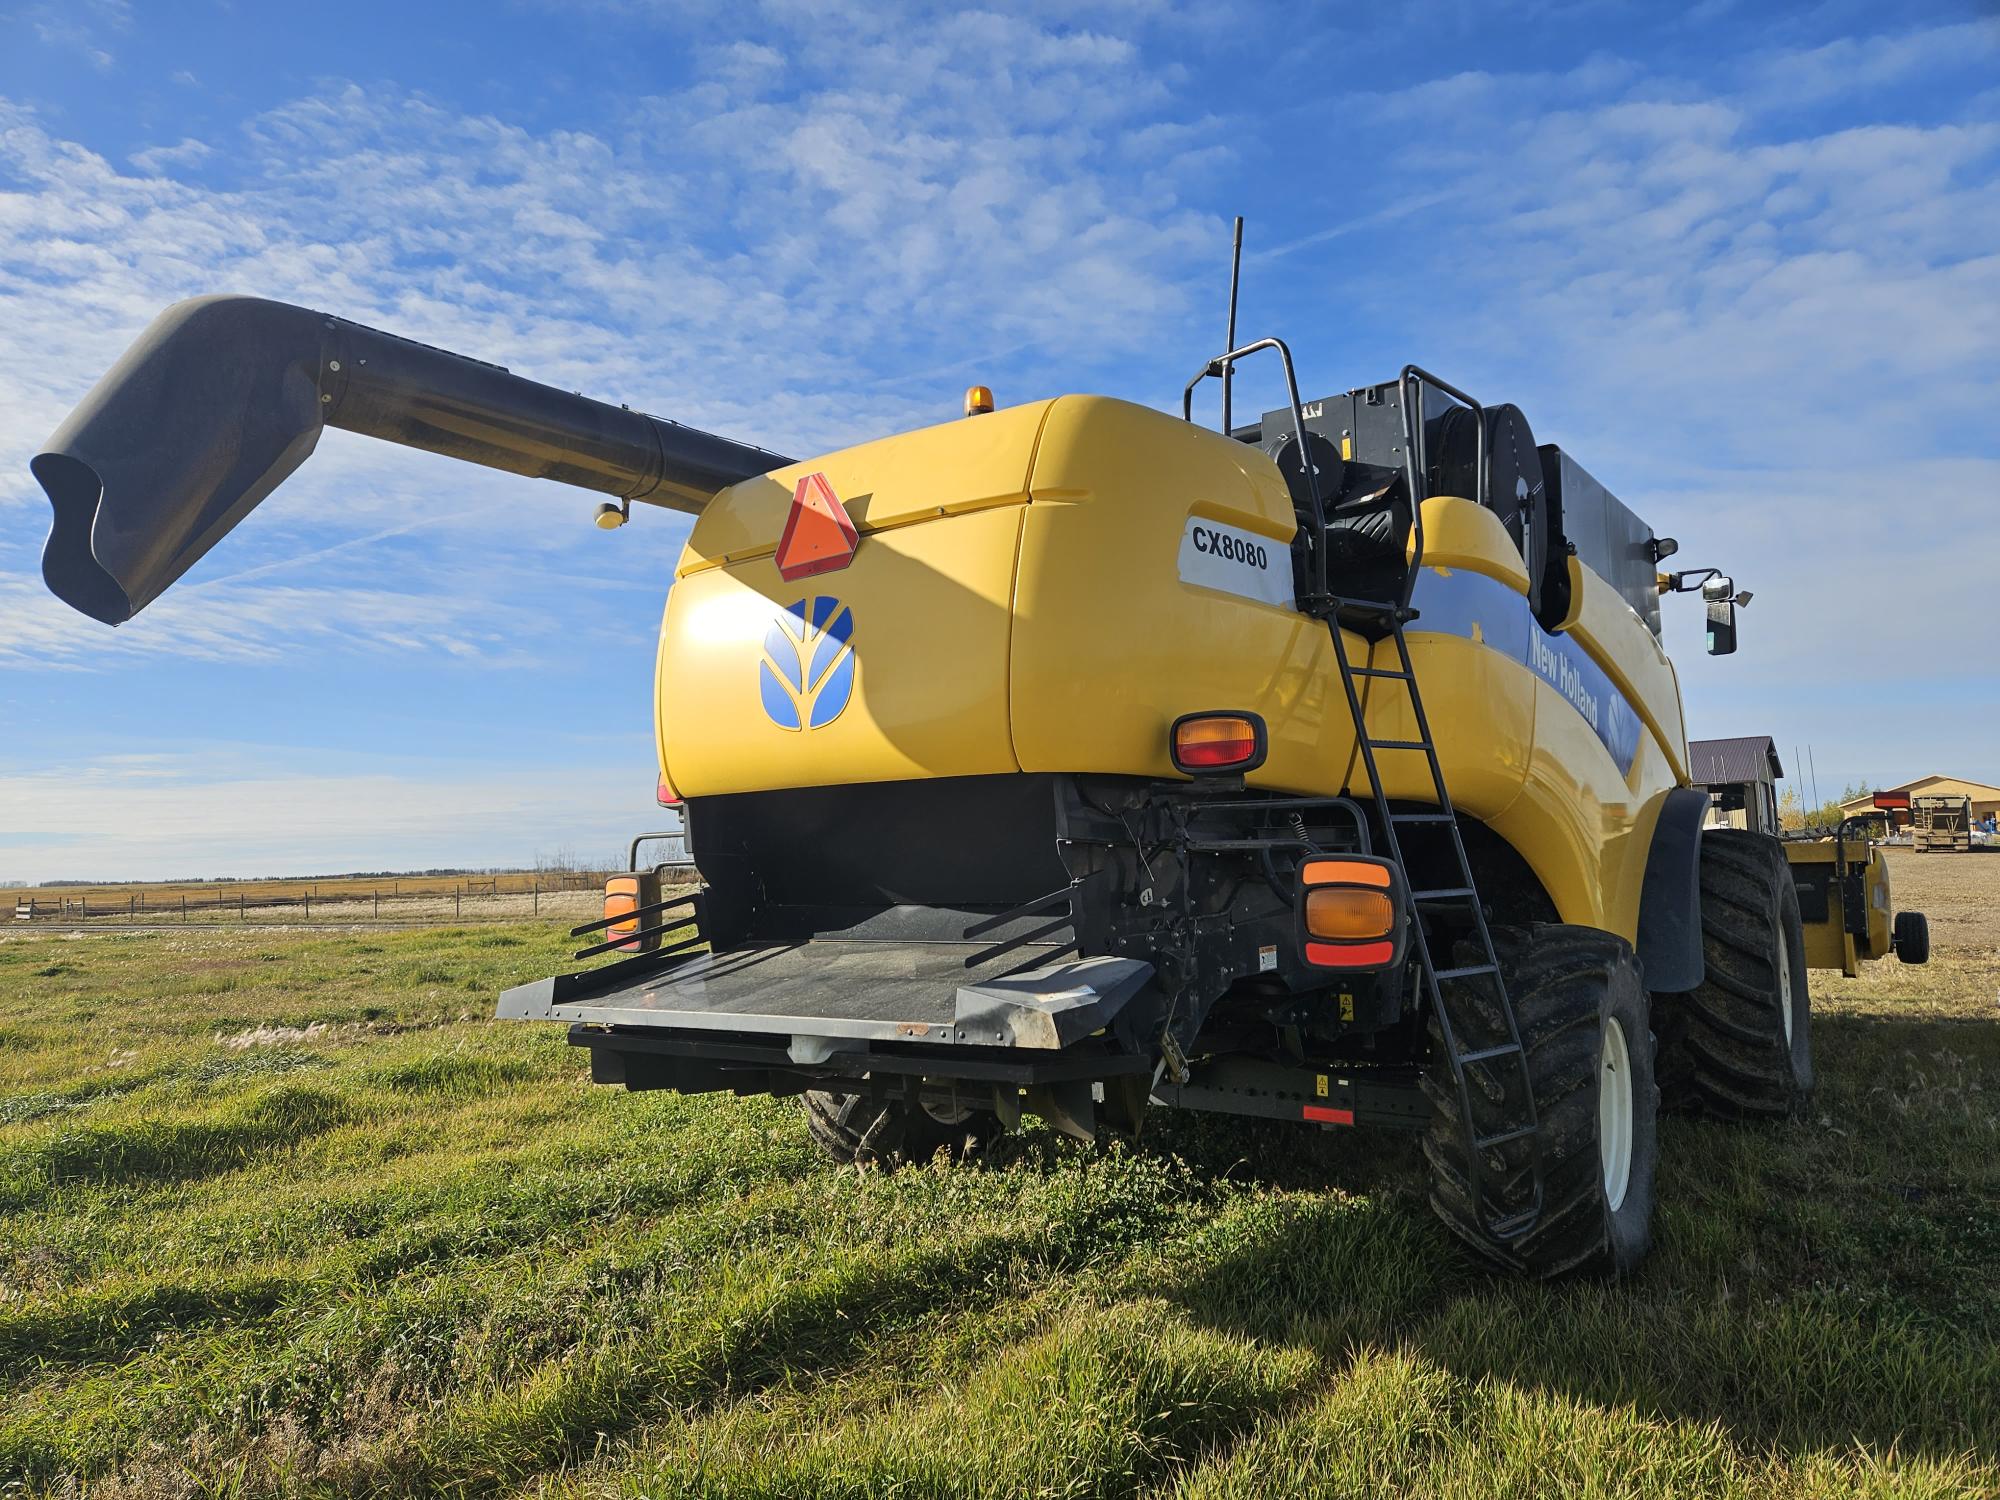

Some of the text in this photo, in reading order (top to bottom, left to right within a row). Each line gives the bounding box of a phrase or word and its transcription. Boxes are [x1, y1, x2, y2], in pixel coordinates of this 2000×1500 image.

[1192, 526, 1268, 570] CX8080
[1532, 625, 1598, 730] New Holland
